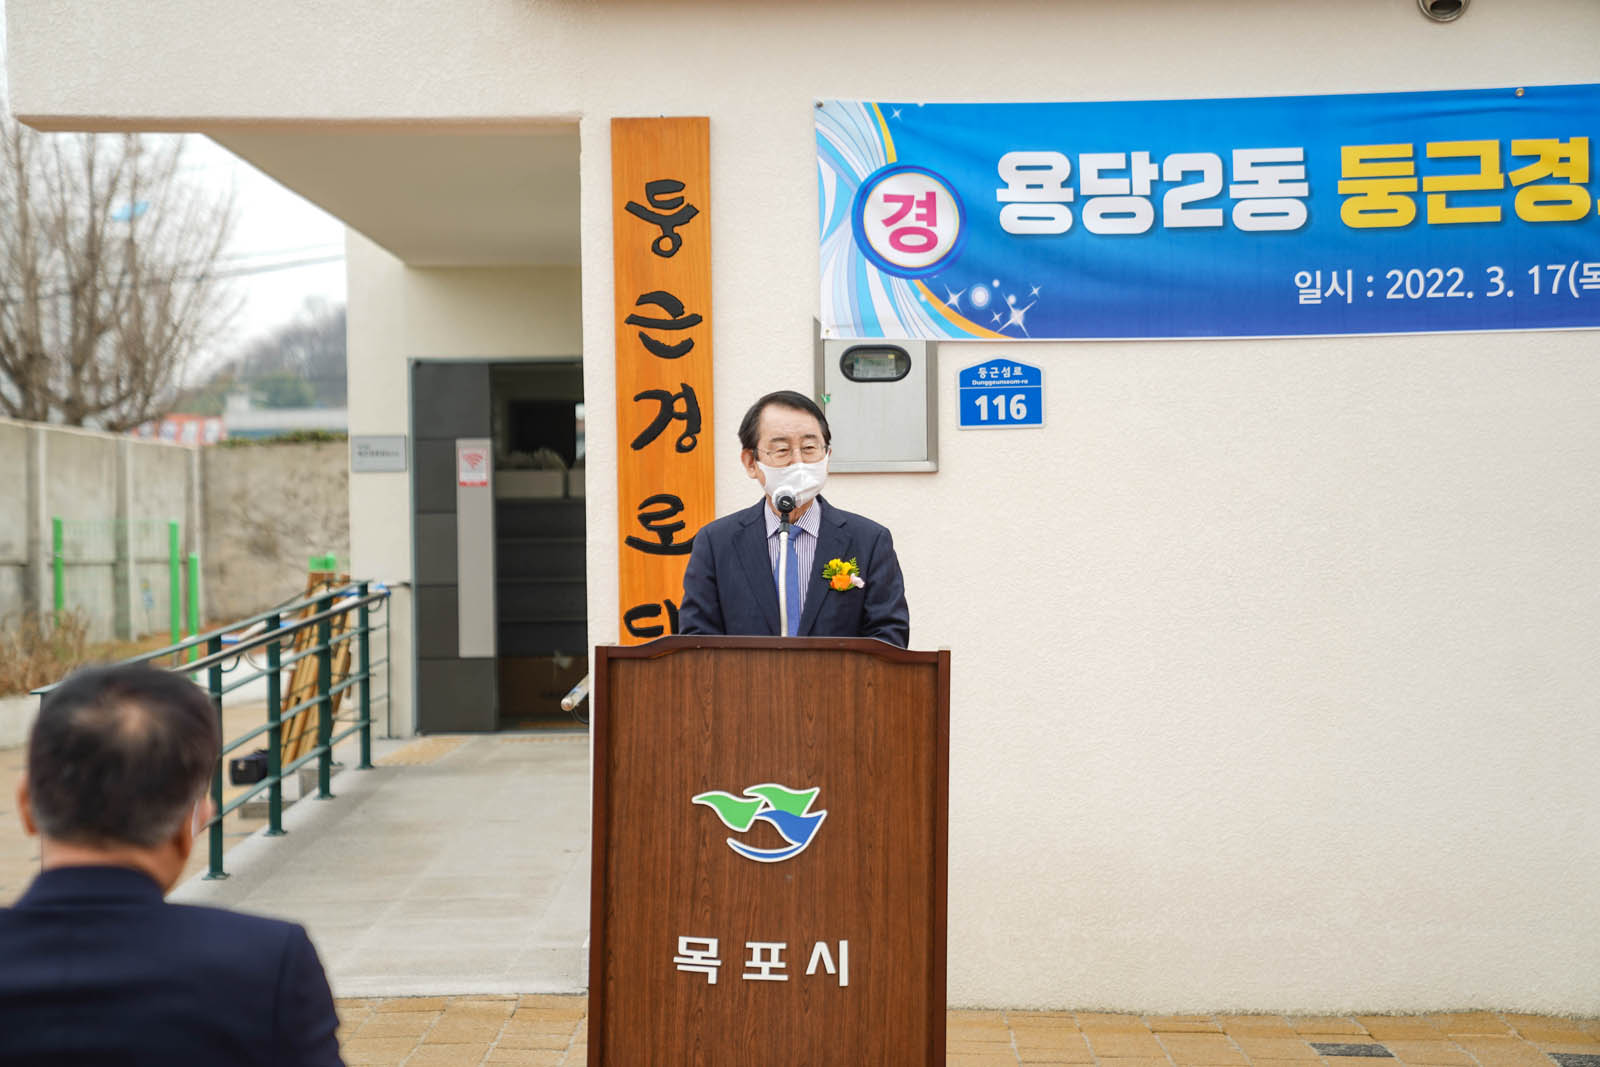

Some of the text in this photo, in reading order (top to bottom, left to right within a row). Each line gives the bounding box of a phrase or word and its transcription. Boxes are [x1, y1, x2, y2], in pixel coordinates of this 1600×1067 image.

[996, 136, 1600, 235] 용당2동 둥근경
[881, 191, 938, 253] 경
[1294, 269, 1353, 305] 일시
[1366, 275, 1374, 298] :
[1386, 267, 1474, 299] 2022.
[1486, 266, 1515, 298] 3.
[978, 366, 1023, 379] 둥근섬로
[974, 394, 1028, 421] 116
[673, 936, 849, 987] 목포시
